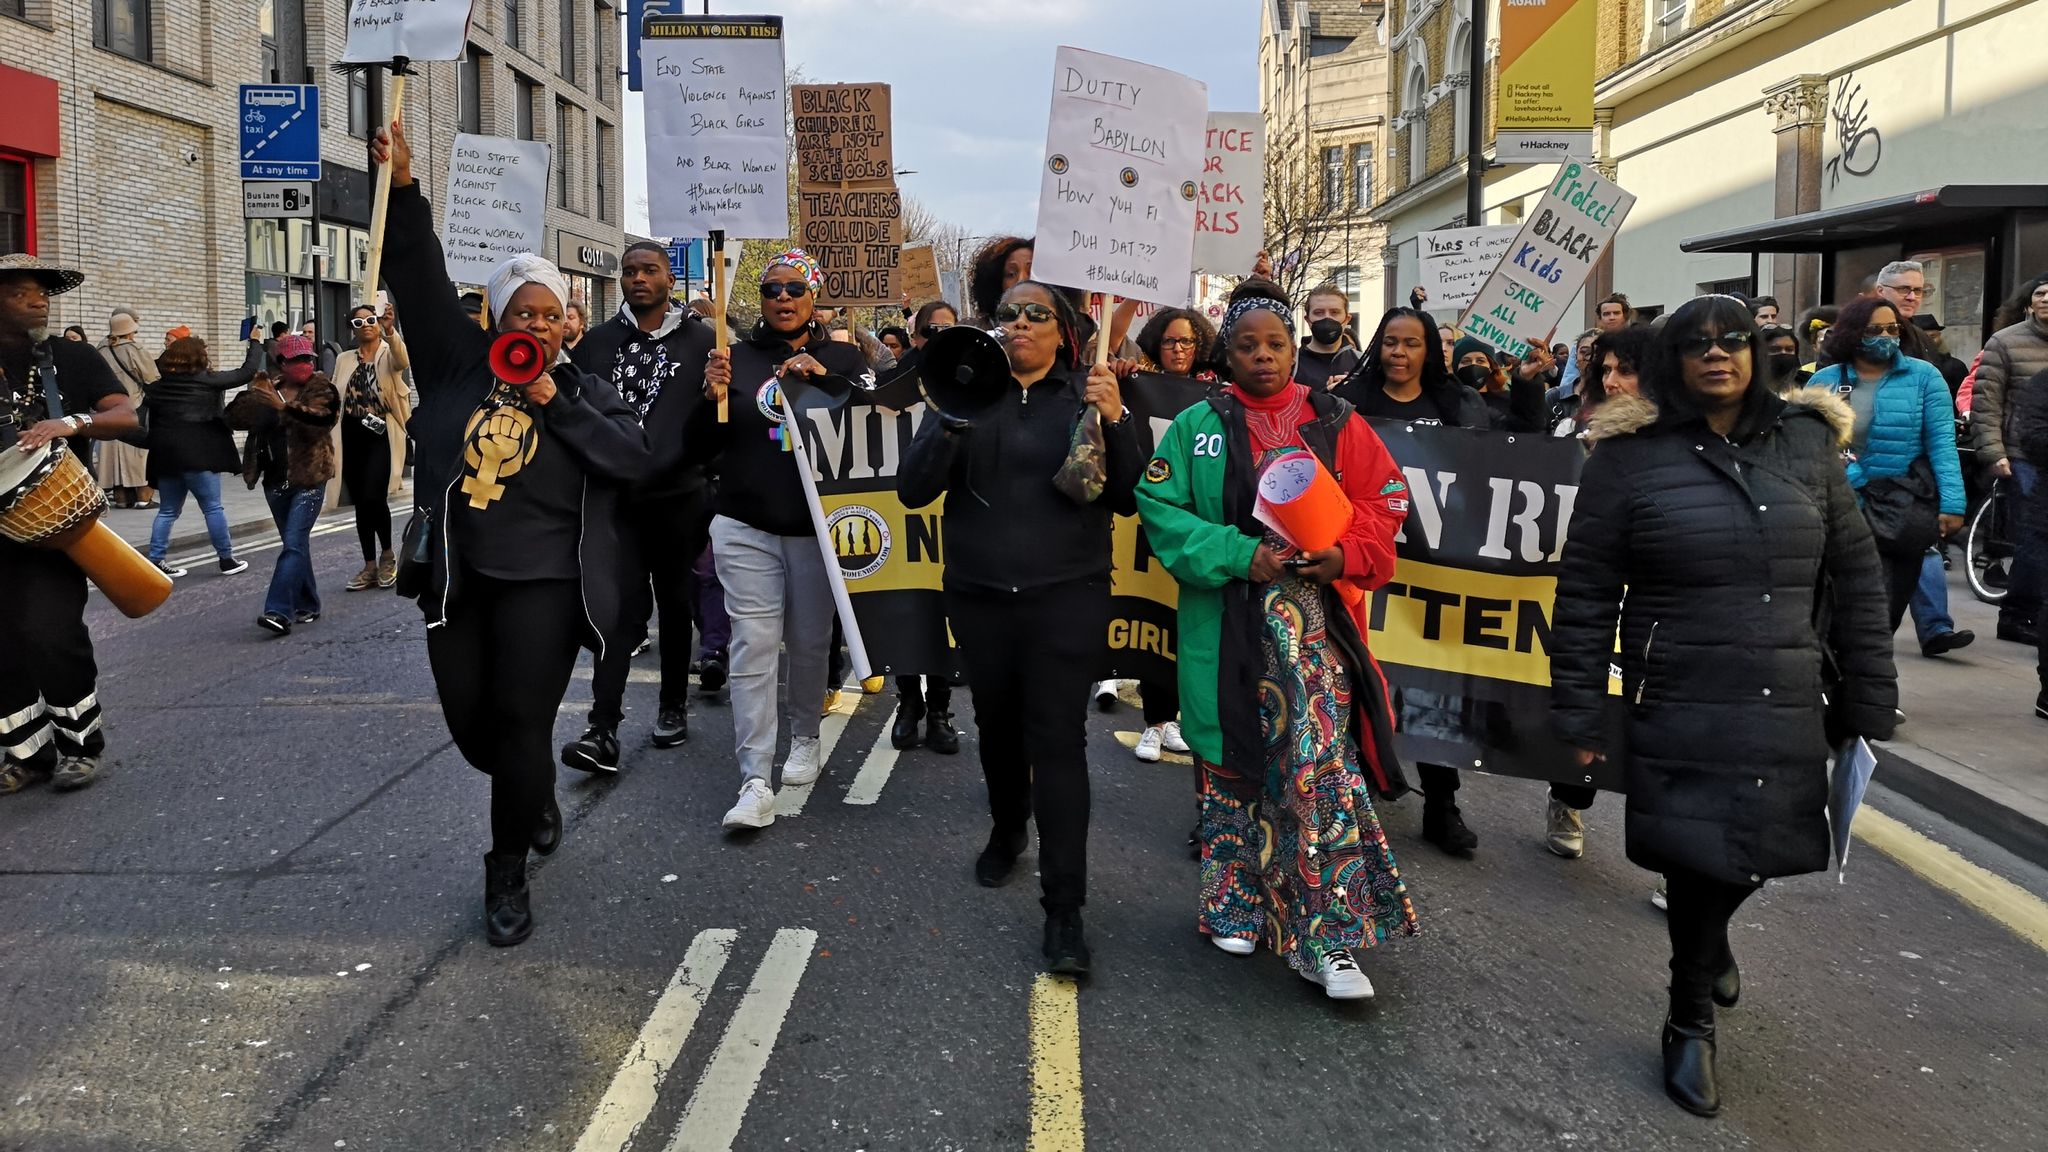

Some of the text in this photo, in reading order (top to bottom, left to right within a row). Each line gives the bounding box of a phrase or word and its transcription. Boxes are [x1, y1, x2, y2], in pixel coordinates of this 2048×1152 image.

[650, 24, 778, 37] MILLION WOMEN RISE
[657, 56, 726, 76] END STATE
[680, 83, 727, 104] VIOLENCE
[1060, 67, 1141, 105] DUTTY
[800, 88, 872, 113] BLACK
[1514, 105, 1562, 113] lovehackney.uk
[245, 125, 264, 134] taxi
[690, 112, 765, 136] BLACK GIRLS
[795, 115, 876, 133] CHILDREN
[798, 130, 884, 150] ARE NOT
[1089, 117, 1165, 158] BABYLON
[1205, 129, 1254, 152] TICE
[1530, 141, 1569, 150] Hackney
[457, 149, 519, 165] END STATE
[676, 156, 777, 173] AND BLACK WOMEN
[802, 147, 868, 166] SAFE IN
[1203, 156, 1223, 174] R
[252, 165, 308, 175] At any time
[456, 163, 504, 176] VIOLENCE
[809, 160, 888, 181] SCHOOLS
[454, 178, 496, 192] AGAINST
[1199, 181, 1244, 204] ACK
[1552, 163, 1622, 227] Protect
[451, 209, 470, 219] AND
[453, 194, 521, 213] BLACK GIRLS
[802, 192, 900, 218] TEACHERS
[1110, 195, 1132, 223] YUH
[1146, 205, 1158, 220] FI
[448, 223, 525, 240] BLACK WOMEN
[806, 220, 890, 243] COLLUDE
[1196, 210, 1240, 235] RLS
[1069, 229, 1157, 262] DUH DAT???
[1427, 235, 1514, 253] YEARS of UNCHEC
[1532, 208, 1599, 263] BLACK
[582, 246, 604, 267] COSTA
[805, 244, 900, 269] WITH THE
[1445, 251, 1503, 267] RACIAL ABUS
[1513, 241, 1562, 284] Kids
[1504, 279, 1545, 312] SACK
[1490, 303, 1517, 326] ALL
[1193, 432, 1223, 457] 20
[1478, 477, 1579, 563] RI
